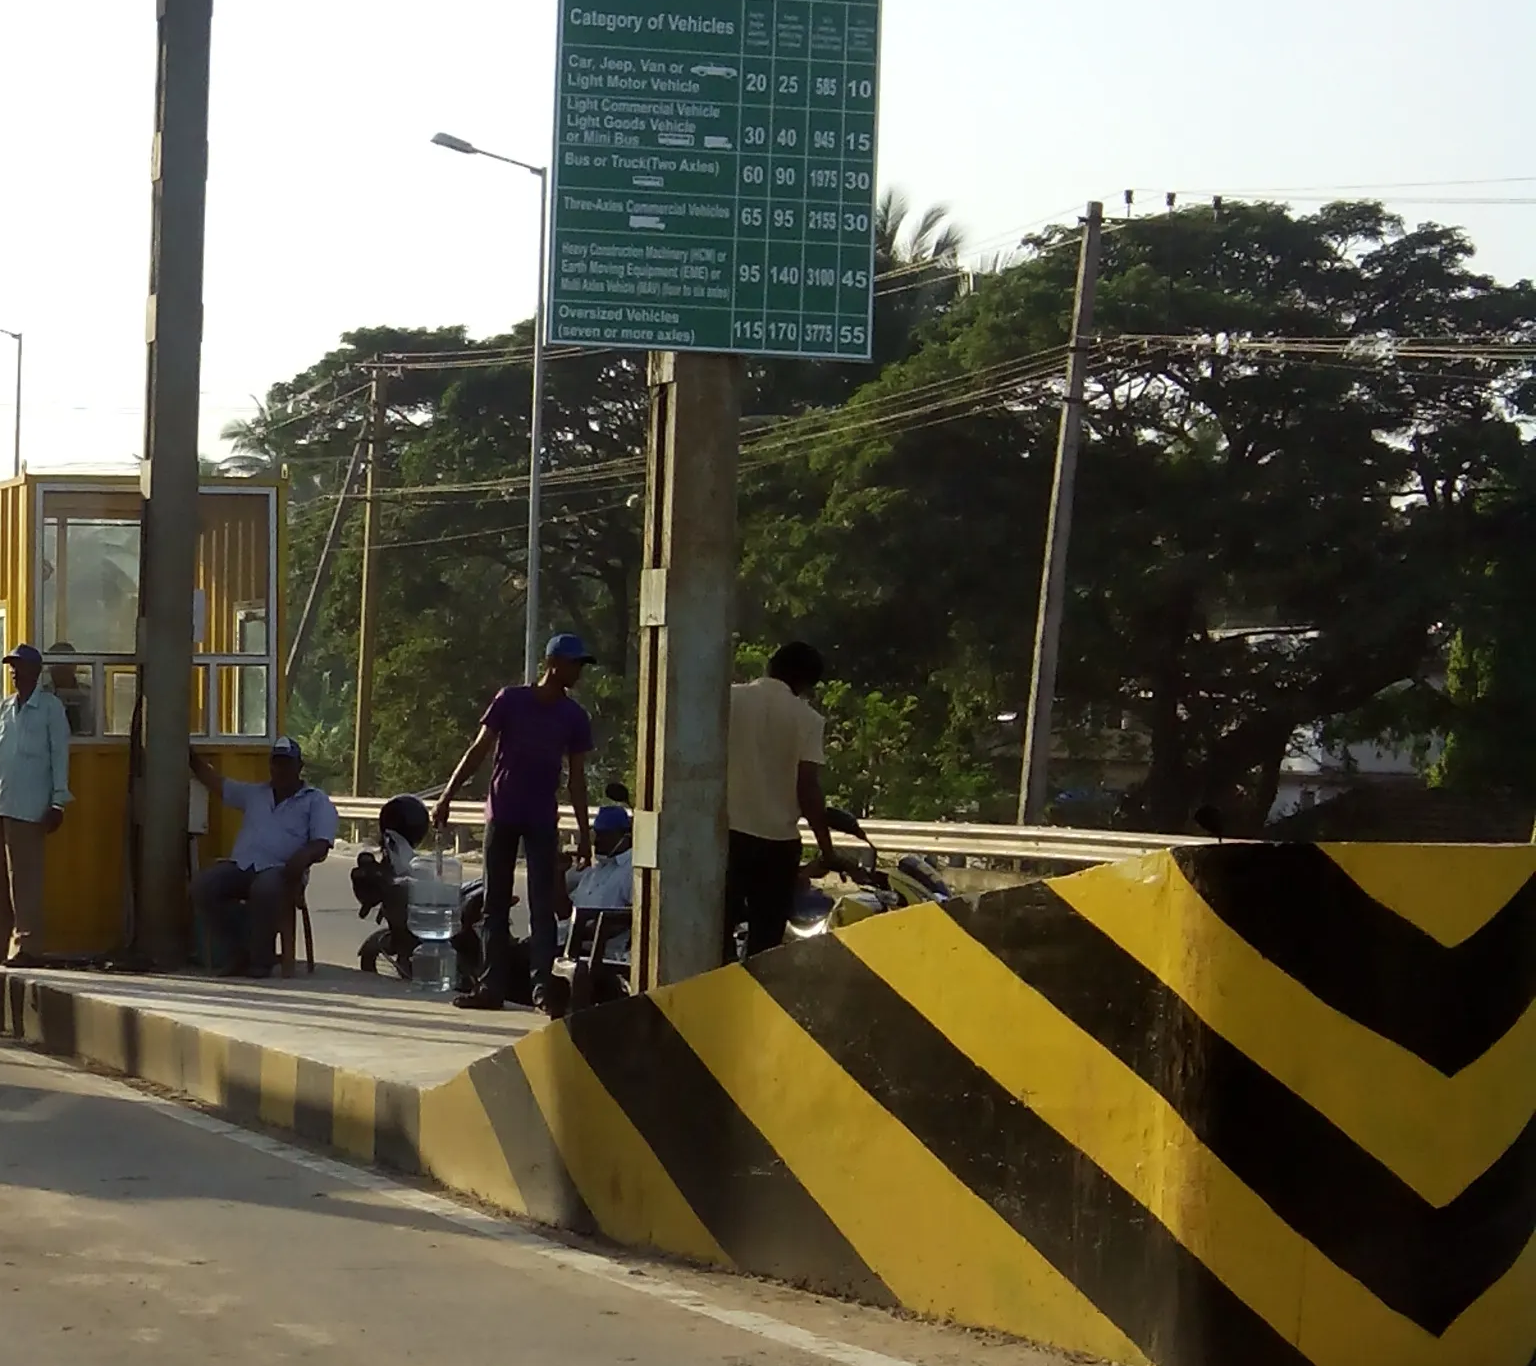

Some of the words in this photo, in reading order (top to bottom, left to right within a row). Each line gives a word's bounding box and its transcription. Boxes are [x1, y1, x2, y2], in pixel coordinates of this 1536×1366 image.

[571, 8, 642, 33] Category
[648, 13, 664, 30] of
[668, 14, 734, 34] Vehicles
[569, 55, 595, 70] Car,
[600, 57, 635, 73] Jeep,
[641, 59, 665, 73] Van
[670, 63, 684, 73] or
[567, 74, 603, 89] Light
[607, 76, 646, 90] Motor
[651, 79, 699, 93] Vehicle
[746, 73, 767, 91] 20
[779, 75, 798, 93] 25
[816, 77, 836, 95] 585
[848, 80, 871, 98] 10
[567, 97, 598, 113] Light
[602, 98, 673, 114] Commercial
[678, 103, 720, 118] Vehicle
[567, 115, 599, 129] Light
[604, 117, 645, 130] Goods
[650, 119, 696, 133] Vehicle
[567, 134, 579, 142] or
[584, 131, 610, 144] Mini
[615, 133, 639, 145] Bus
[745, 127, 765, 144] 30
[777, 129, 796, 147] 40
[814, 131, 835, 148] 945
[846, 134, 870, 151] 15
[565, 152, 589, 166] Bus
[594, 157, 607, 166] or
[680, 159, 719, 176] Axles)
[743, 166, 764, 183] 60
[776, 168, 795, 185] 90
[810, 170, 837, 187] 1975
[845, 172, 869, 190] 30
[626, 200, 685, 216] Commercial
[741, 208, 762, 226] 65
[774, 209, 794, 227] 95
[809, 211, 836, 229] 2155
[844, 214, 867, 232] 30
[562, 243, 587, 257] Heavy
[590, 243, 644, 258] Construction
[718, 252, 727, 262] or
[562, 261, 586, 273] Earth
[589, 263, 624, 278] Moving
[627, 263, 678, 279] Equipment
[711, 270, 721, 280] or
[739, 265, 760, 282] 95
[770, 267, 798, 284] 140
[807, 268, 834, 286] 3100
[842, 271, 867, 288] 45
[559, 305, 622, 320] Oversized
[626, 309, 679, 323] Vehicles
[558, 323, 599, 337] (seven
[604, 328, 616, 337] or
[621, 330, 654, 340] more
[657, 329, 694, 345] axles)
[735, 321, 762, 338] 115
[769, 323, 796, 340] 170
[805, 325, 832, 341] 3775
[840, 327, 865, 343] 55
